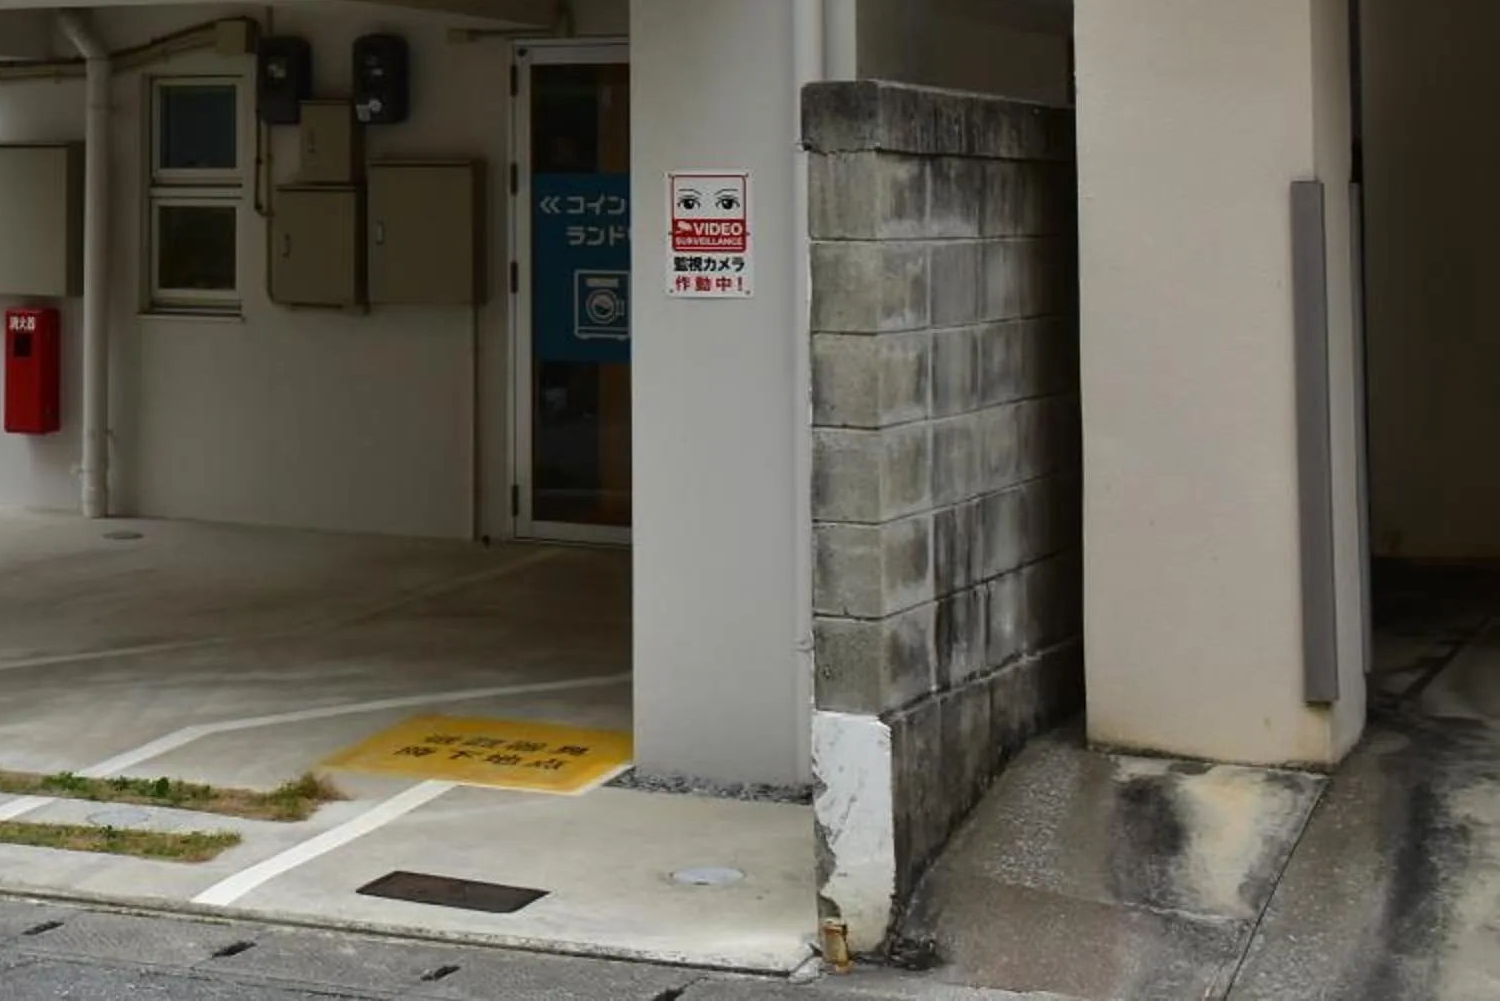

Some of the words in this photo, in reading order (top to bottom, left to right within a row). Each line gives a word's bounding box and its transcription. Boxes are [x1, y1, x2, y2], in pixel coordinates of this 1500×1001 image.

[566, 225, 631, 248] ランド
[693, 222, 743, 236] VIDEO
[675, 237, 744, 246] SURVEILLANCE
[673, 256, 745, 272] 監視カメラ
